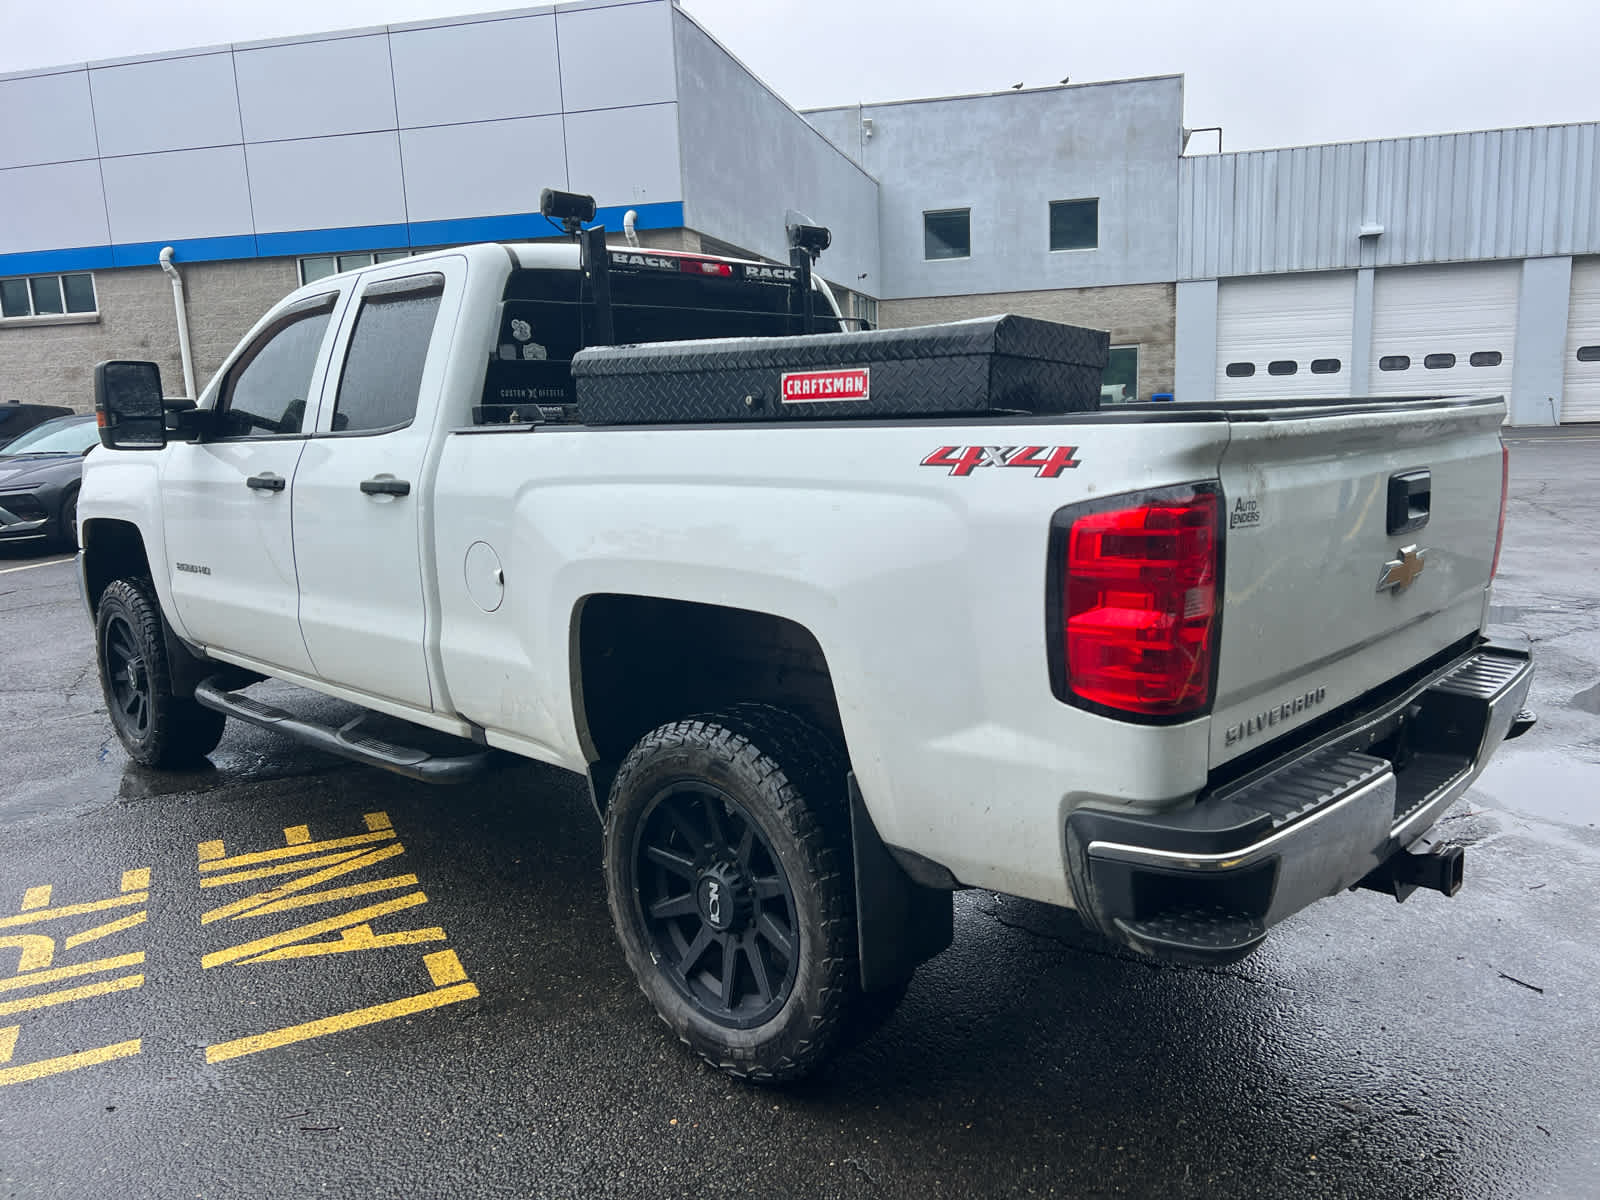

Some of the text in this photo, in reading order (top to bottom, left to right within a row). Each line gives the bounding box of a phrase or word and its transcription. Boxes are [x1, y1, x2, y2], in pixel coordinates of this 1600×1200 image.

[612, 253, 798, 280] BACK RACK
[787, 376, 863, 395] CRAFTSMAN
[1225, 686, 1327, 747] SILVERADO
[709, 882, 720, 924] ION
[198, 811, 480, 1064] LANE
